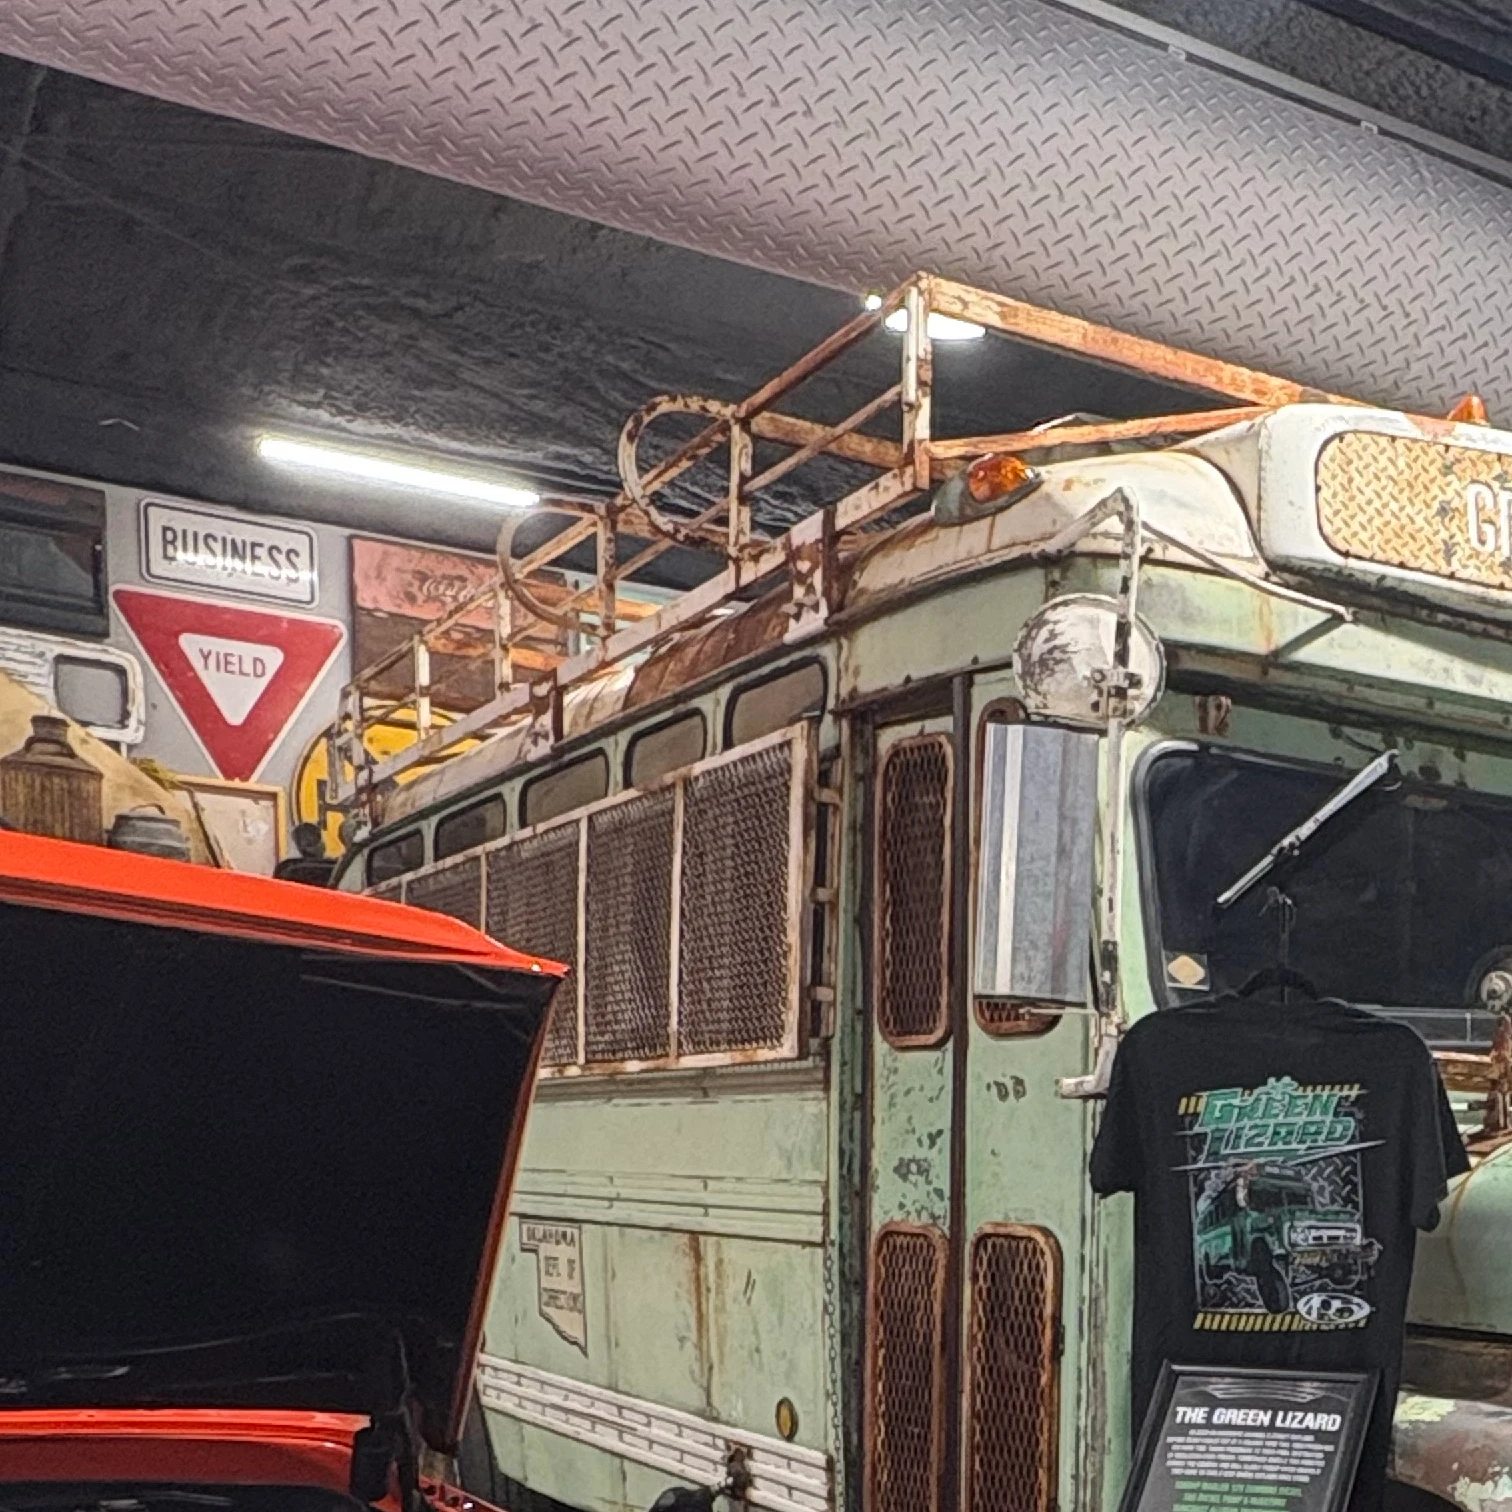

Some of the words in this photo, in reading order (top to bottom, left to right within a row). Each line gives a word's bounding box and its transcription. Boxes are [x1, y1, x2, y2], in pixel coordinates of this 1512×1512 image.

[161, 525, 301, 584] BUSINESS
[199, 648, 267, 679] YIELD
[1174, 1406, 1209, 1424] THE
[1212, 1407, 1273, 1428] GREEN
[1275, 1410, 1342, 1432] LIZARD
